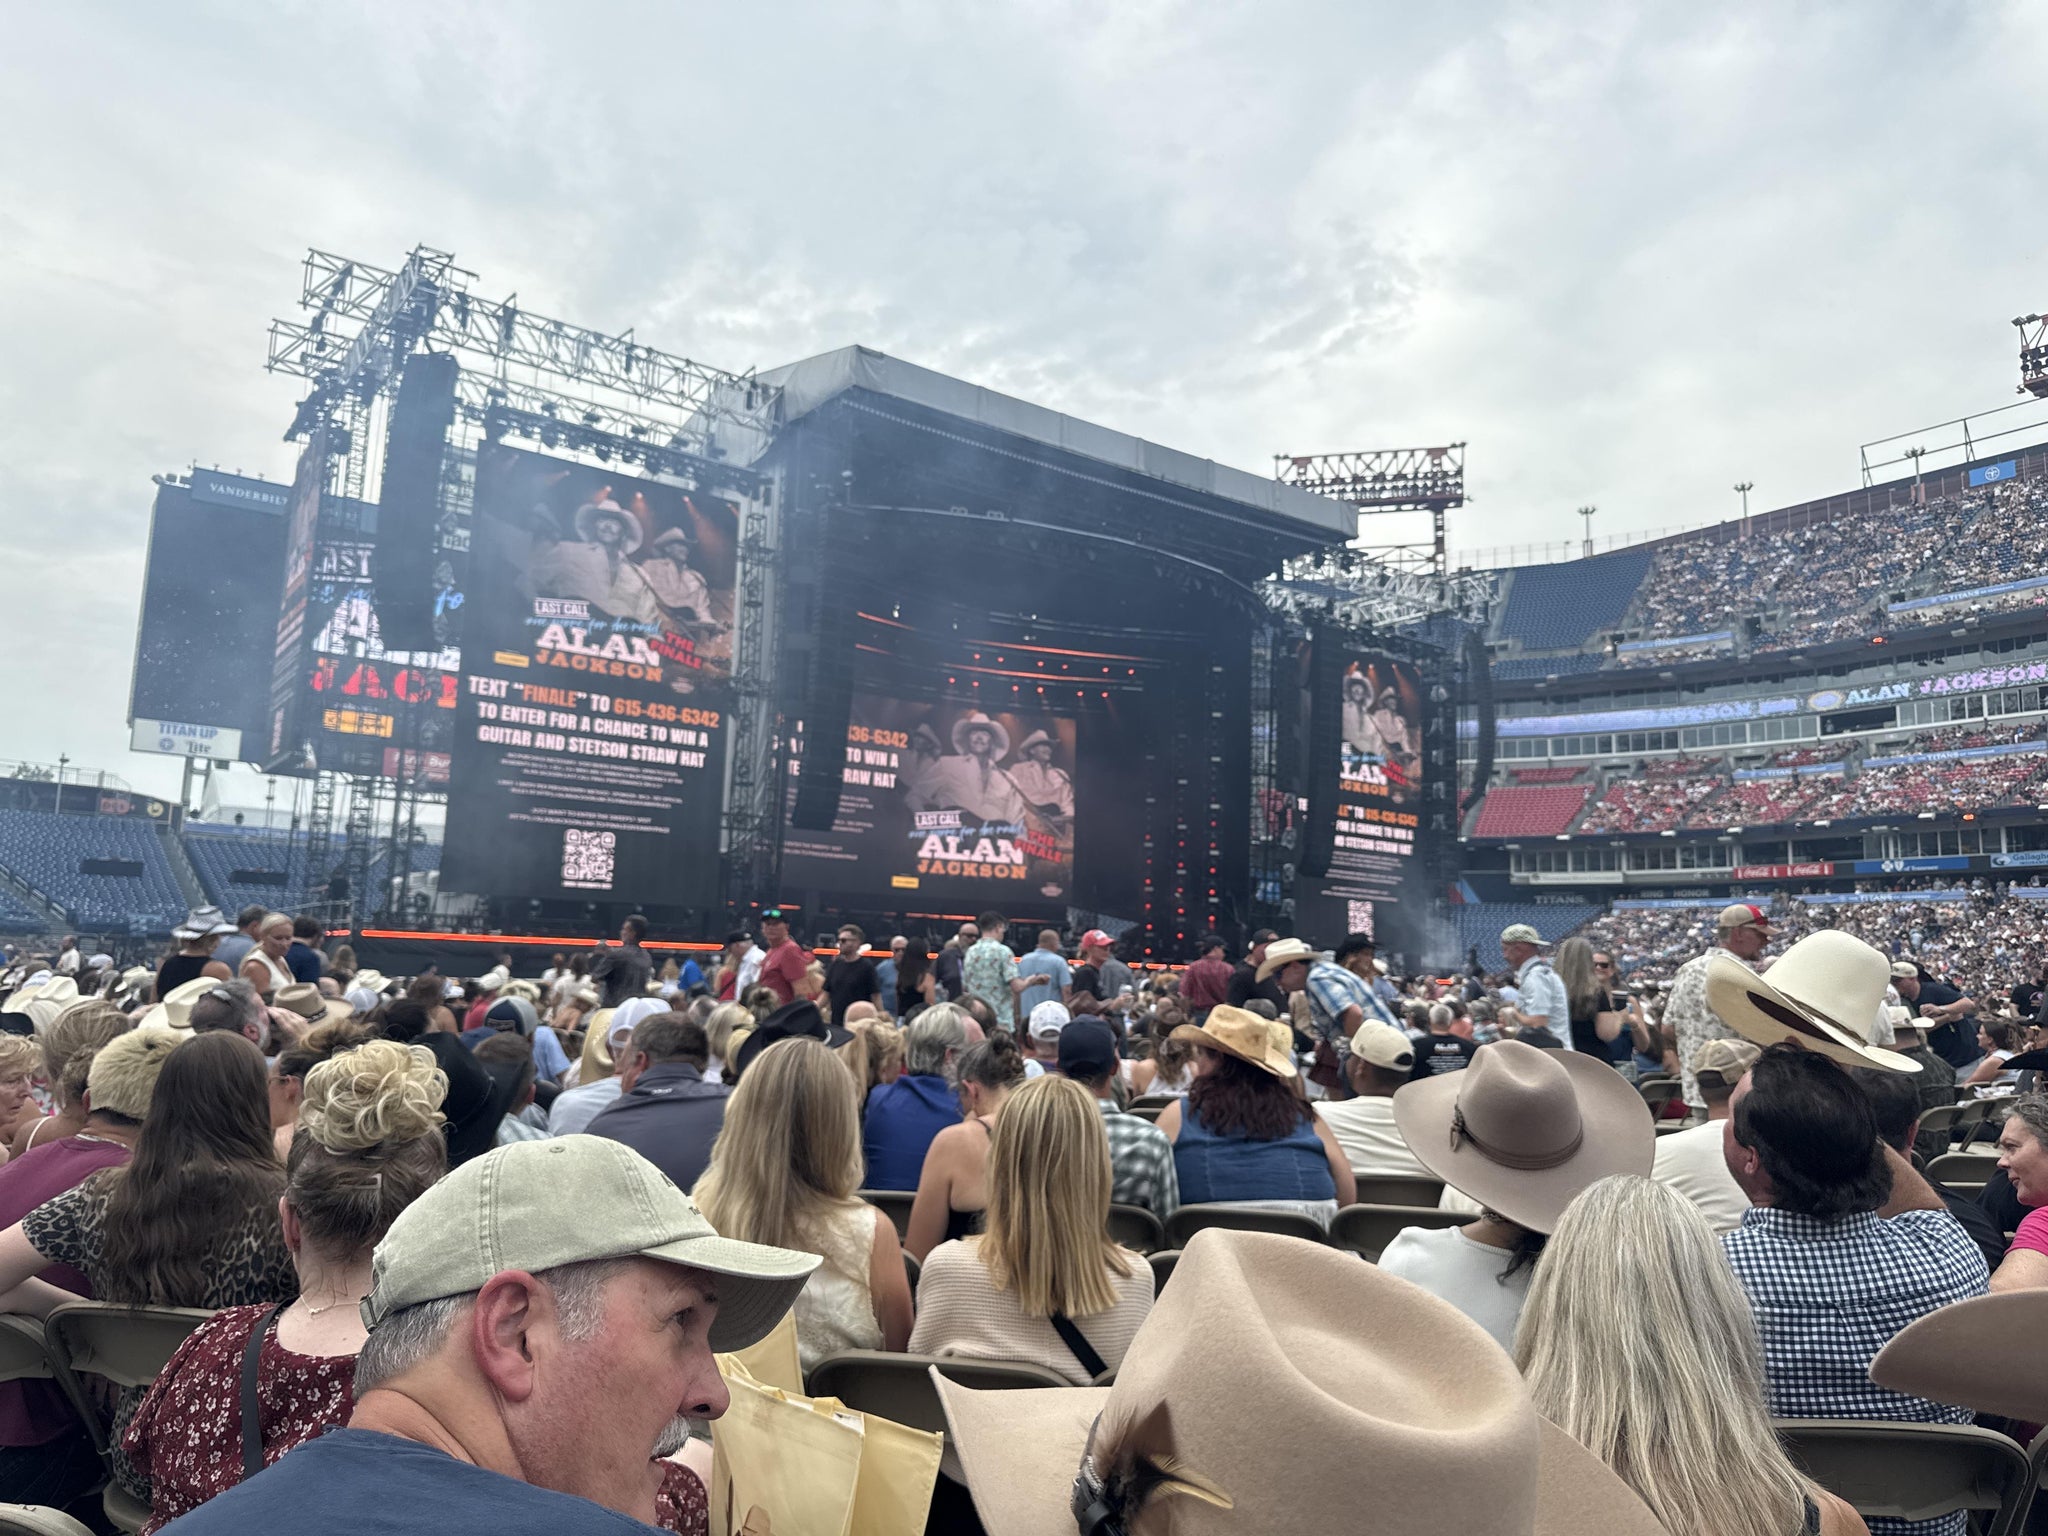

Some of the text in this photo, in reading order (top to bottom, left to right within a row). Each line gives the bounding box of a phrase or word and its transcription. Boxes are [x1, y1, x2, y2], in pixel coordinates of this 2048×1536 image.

[535, 601, 590, 617] LAST CALL
[536, 624, 660, 667] ALAN
[664, 630, 695, 652] THE
[649, 638, 702, 670] FINALE
[535, 649, 663, 684] JACKSON
[1847, 663, 2047, 702] ALAN JACKSON
[467, 674, 510, 699] TEXT
[590, 693, 611, 713] TO
[613, 697, 720, 728] 615-436-6342
[159, 722, 218, 739] TITAN UP
[477, 701, 709, 748] TO ENTER FOR A CHANCE TO WIN A
[477, 724, 533, 748] GUITAR
[534, 731, 566, 751] AND
[568, 736, 629, 760] STETSON
[630, 743, 678, 766] STRAW
[679, 751, 706, 769] HAT
[846, 747, 899, 769] TO WIN A
[873, 771, 897, 789] HAT
[1340, 761, 1388, 785] LAN
[915, 813, 961, 826] LAST CALL
[917, 834, 1024, 864] ALAN
[1027, 829, 1056, 848] THE
[1013, 838, 1064, 864] FINALE
[917, 859, 1028, 880] JACKSON
[1534, 894, 1586, 905] TITANS
[1673, 888, 1711, 898] HONOR
